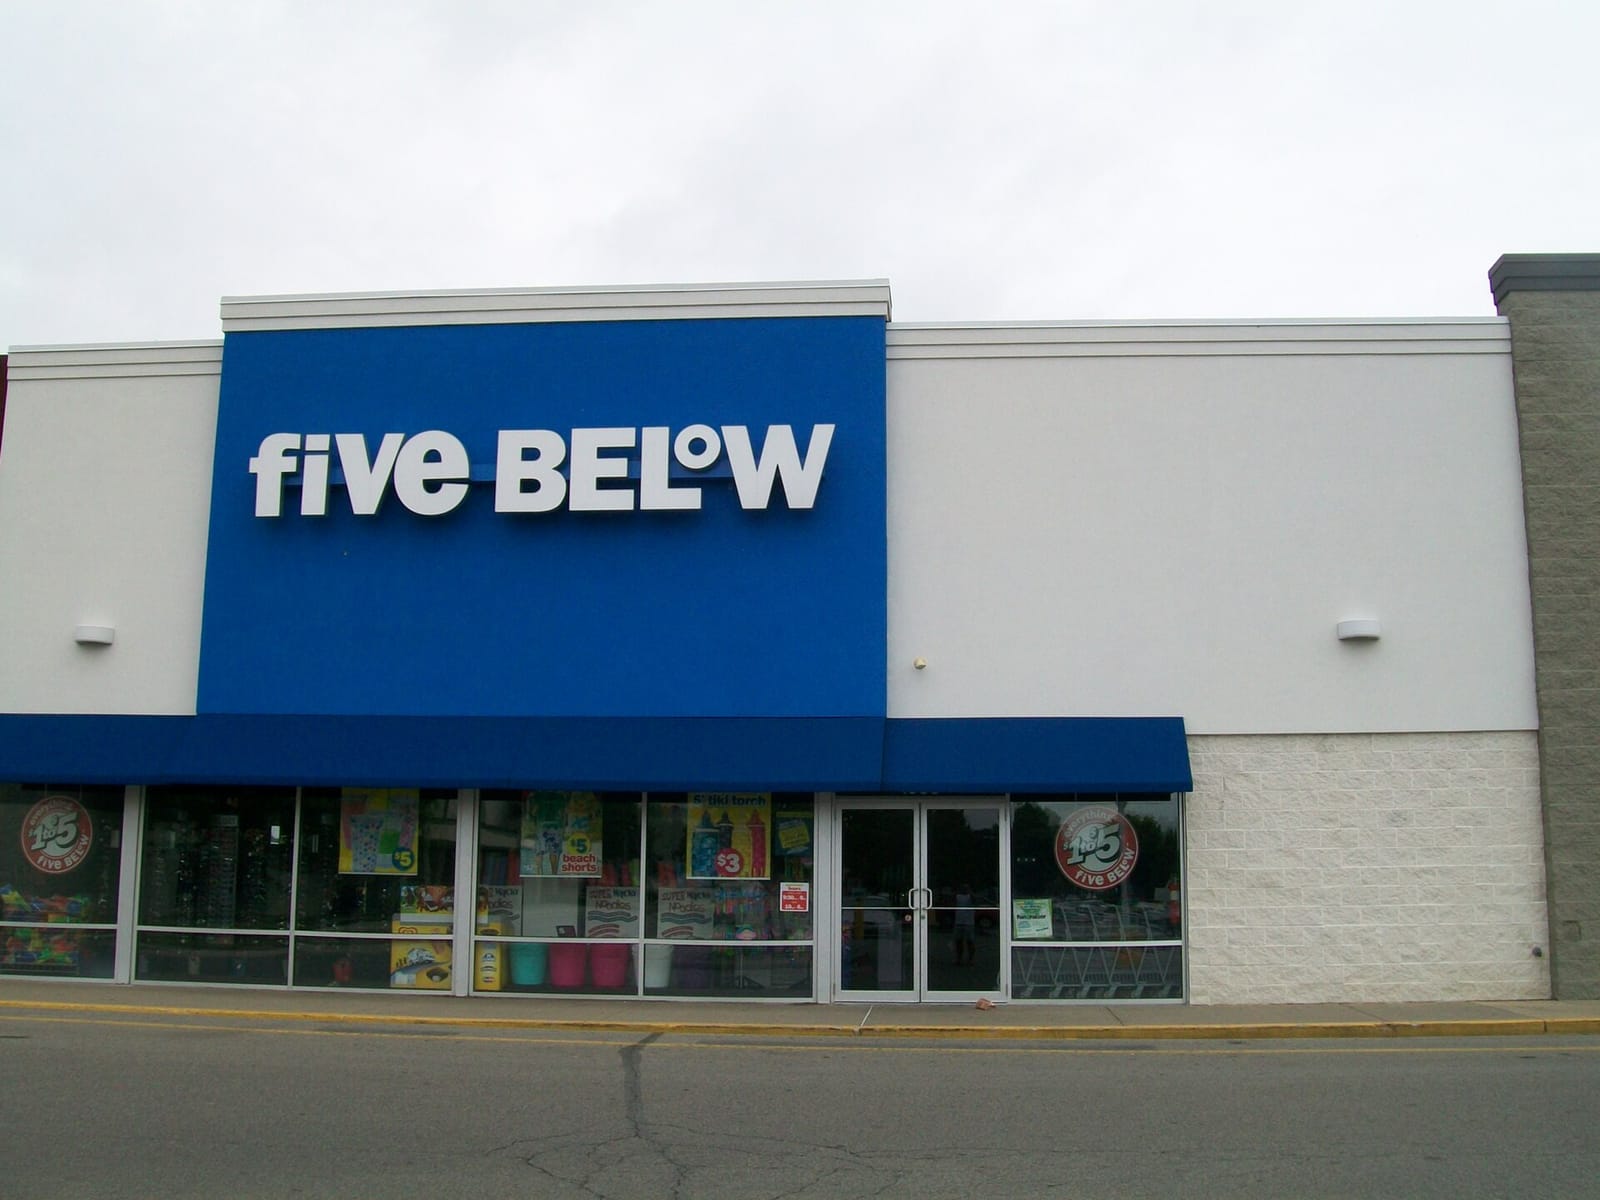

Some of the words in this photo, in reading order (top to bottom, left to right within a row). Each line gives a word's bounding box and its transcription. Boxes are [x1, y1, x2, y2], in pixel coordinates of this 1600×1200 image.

[249, 430, 470, 517] five
[562, 853, 596, 863] beach
[717, 853, 740, 873] $3
[561, 862, 597, 872] shorts
[1075, 869, 1104, 886] five
